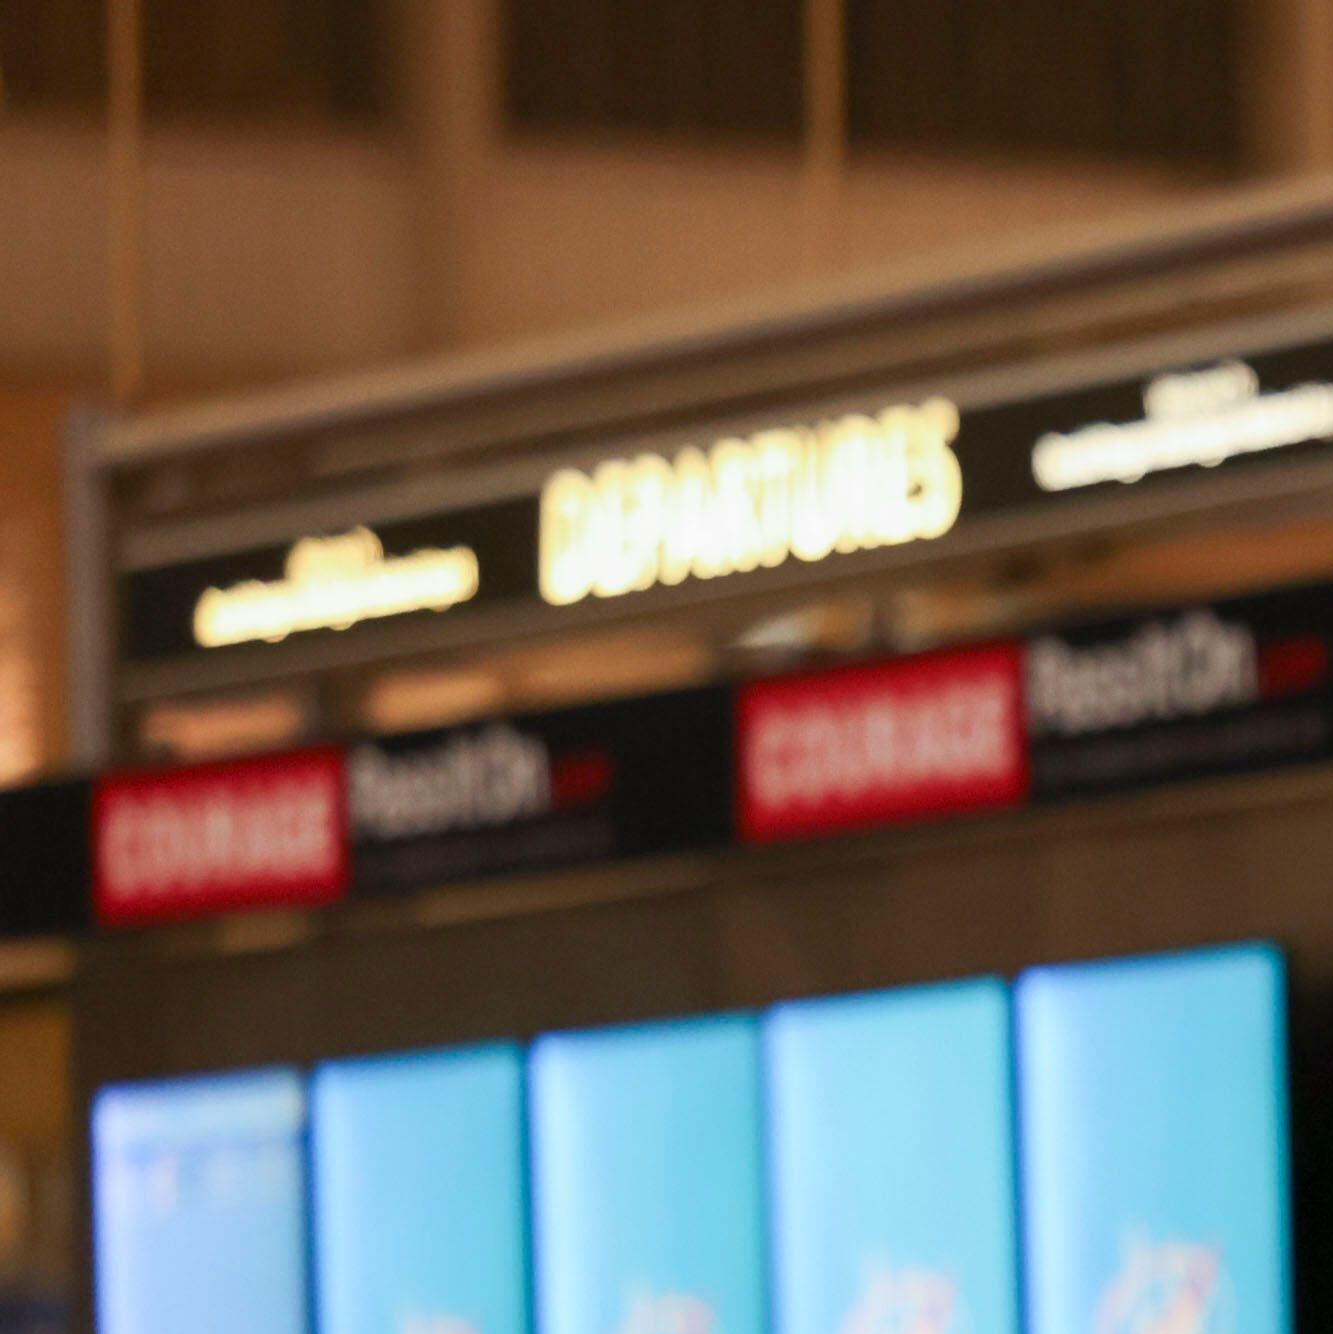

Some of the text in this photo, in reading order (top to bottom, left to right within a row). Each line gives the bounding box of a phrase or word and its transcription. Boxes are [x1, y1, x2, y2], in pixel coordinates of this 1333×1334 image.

[540, 397, 961, 606] DEPARTURES
[745, 680, 1012, 806] COURAGE
[104, 772, 338, 900] COURAGE
